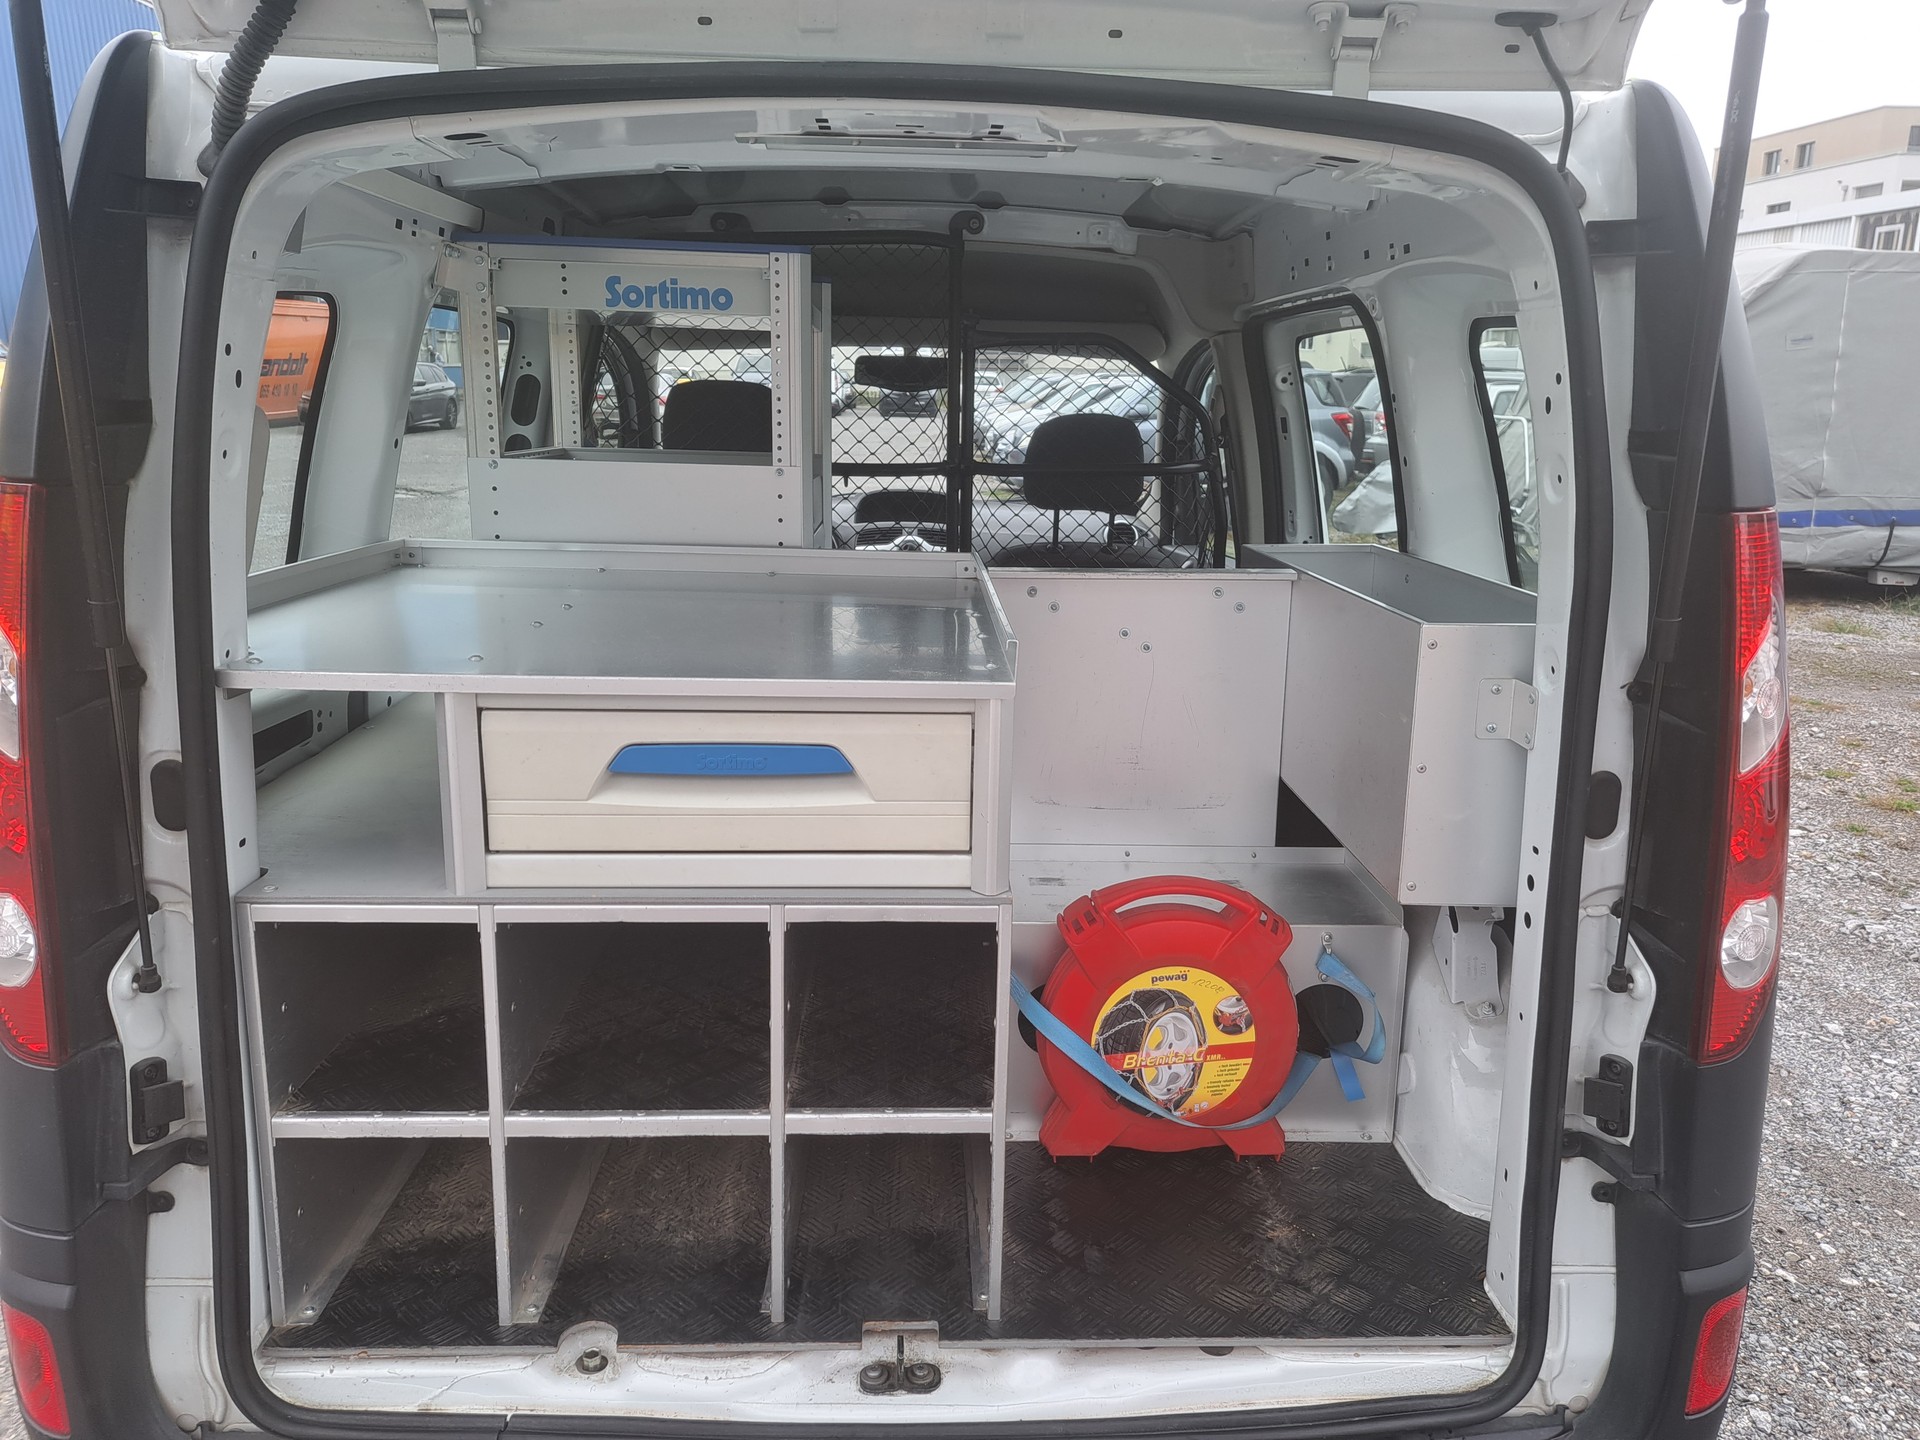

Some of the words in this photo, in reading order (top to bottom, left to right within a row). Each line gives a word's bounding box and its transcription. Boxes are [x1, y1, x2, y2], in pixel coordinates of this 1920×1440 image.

[605, 275, 734, 311] Sortimo
[697, 753, 768, 770] Sortimo
[1151, 973, 1188, 984] pewag
[1123, 1047, 1206, 1069] Brenta-C
